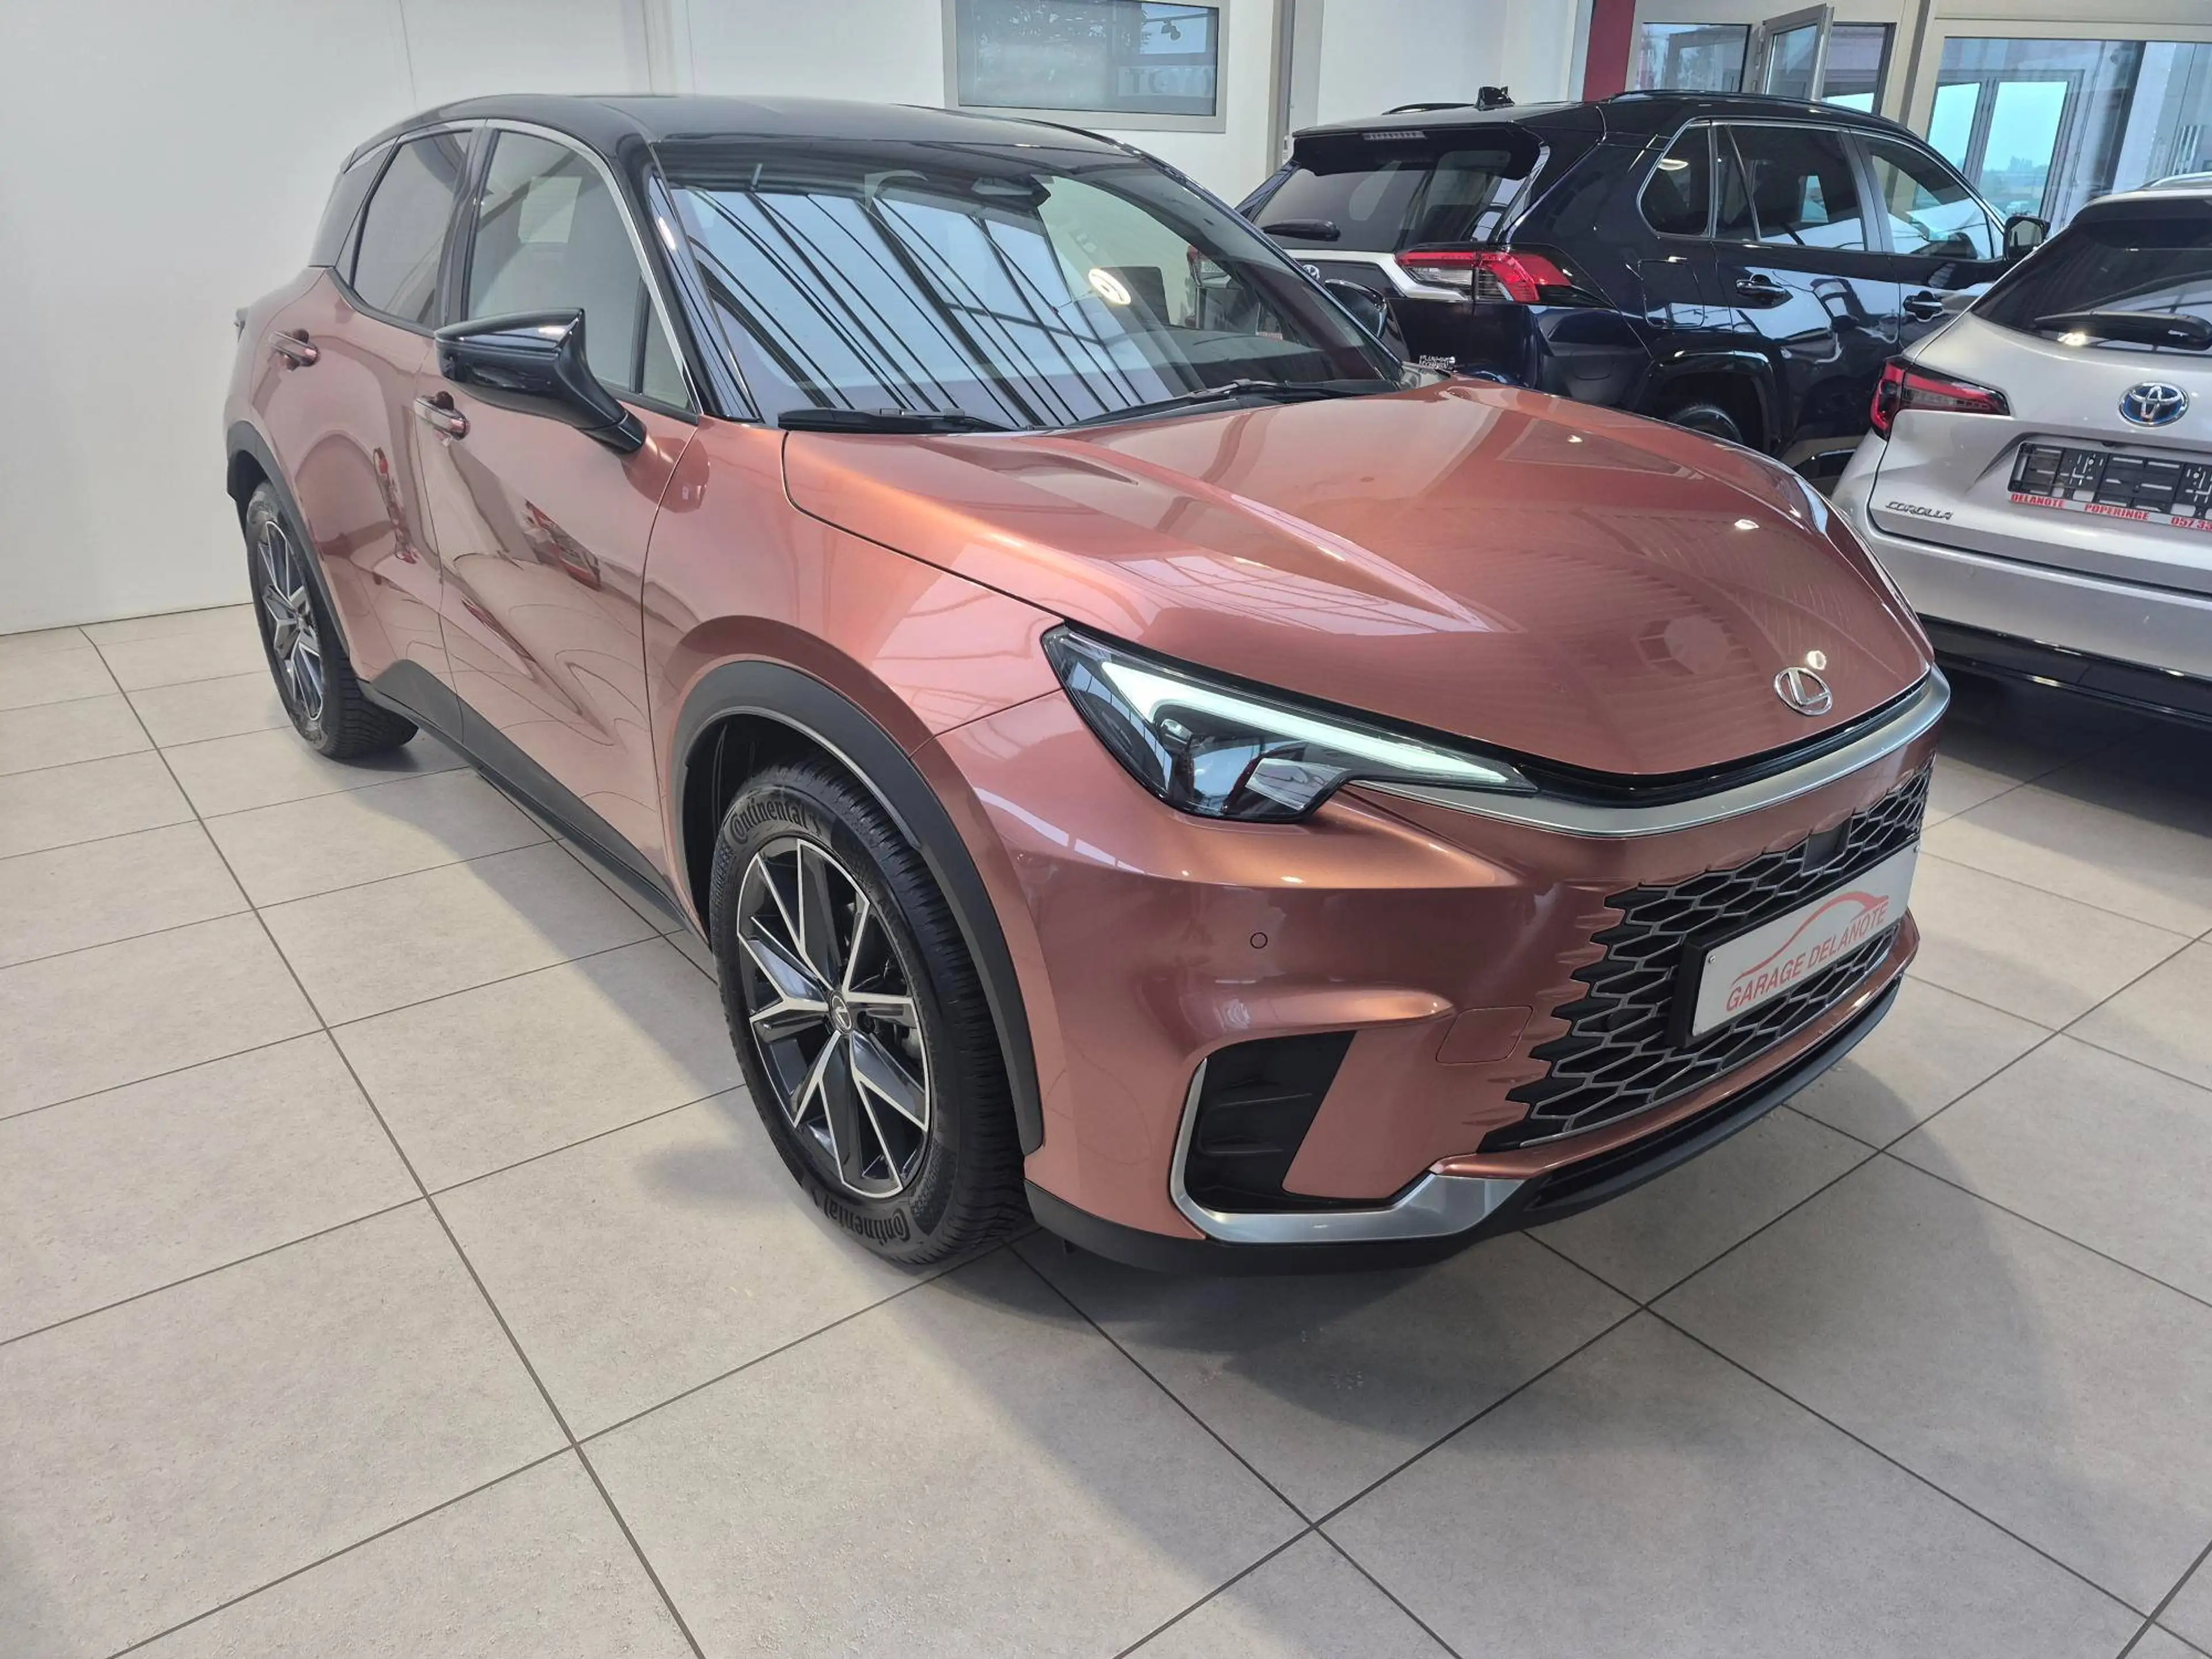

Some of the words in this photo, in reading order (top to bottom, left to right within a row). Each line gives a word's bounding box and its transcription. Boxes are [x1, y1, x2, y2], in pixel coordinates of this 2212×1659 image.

[1885, 501, 1953, 520] COROLLA
[2010, 493, 2065, 509] DELANOTE
[2084, 502, 2150, 521] POPERINGE
[2171, 516, 2195, 527] 057
[730, 798, 809, 844] Continental
[1726, 952, 1806, 1012] GARAGE
[1808, 902, 1888, 969] DELANOTE
[823, 1194, 911, 1246] Continental
